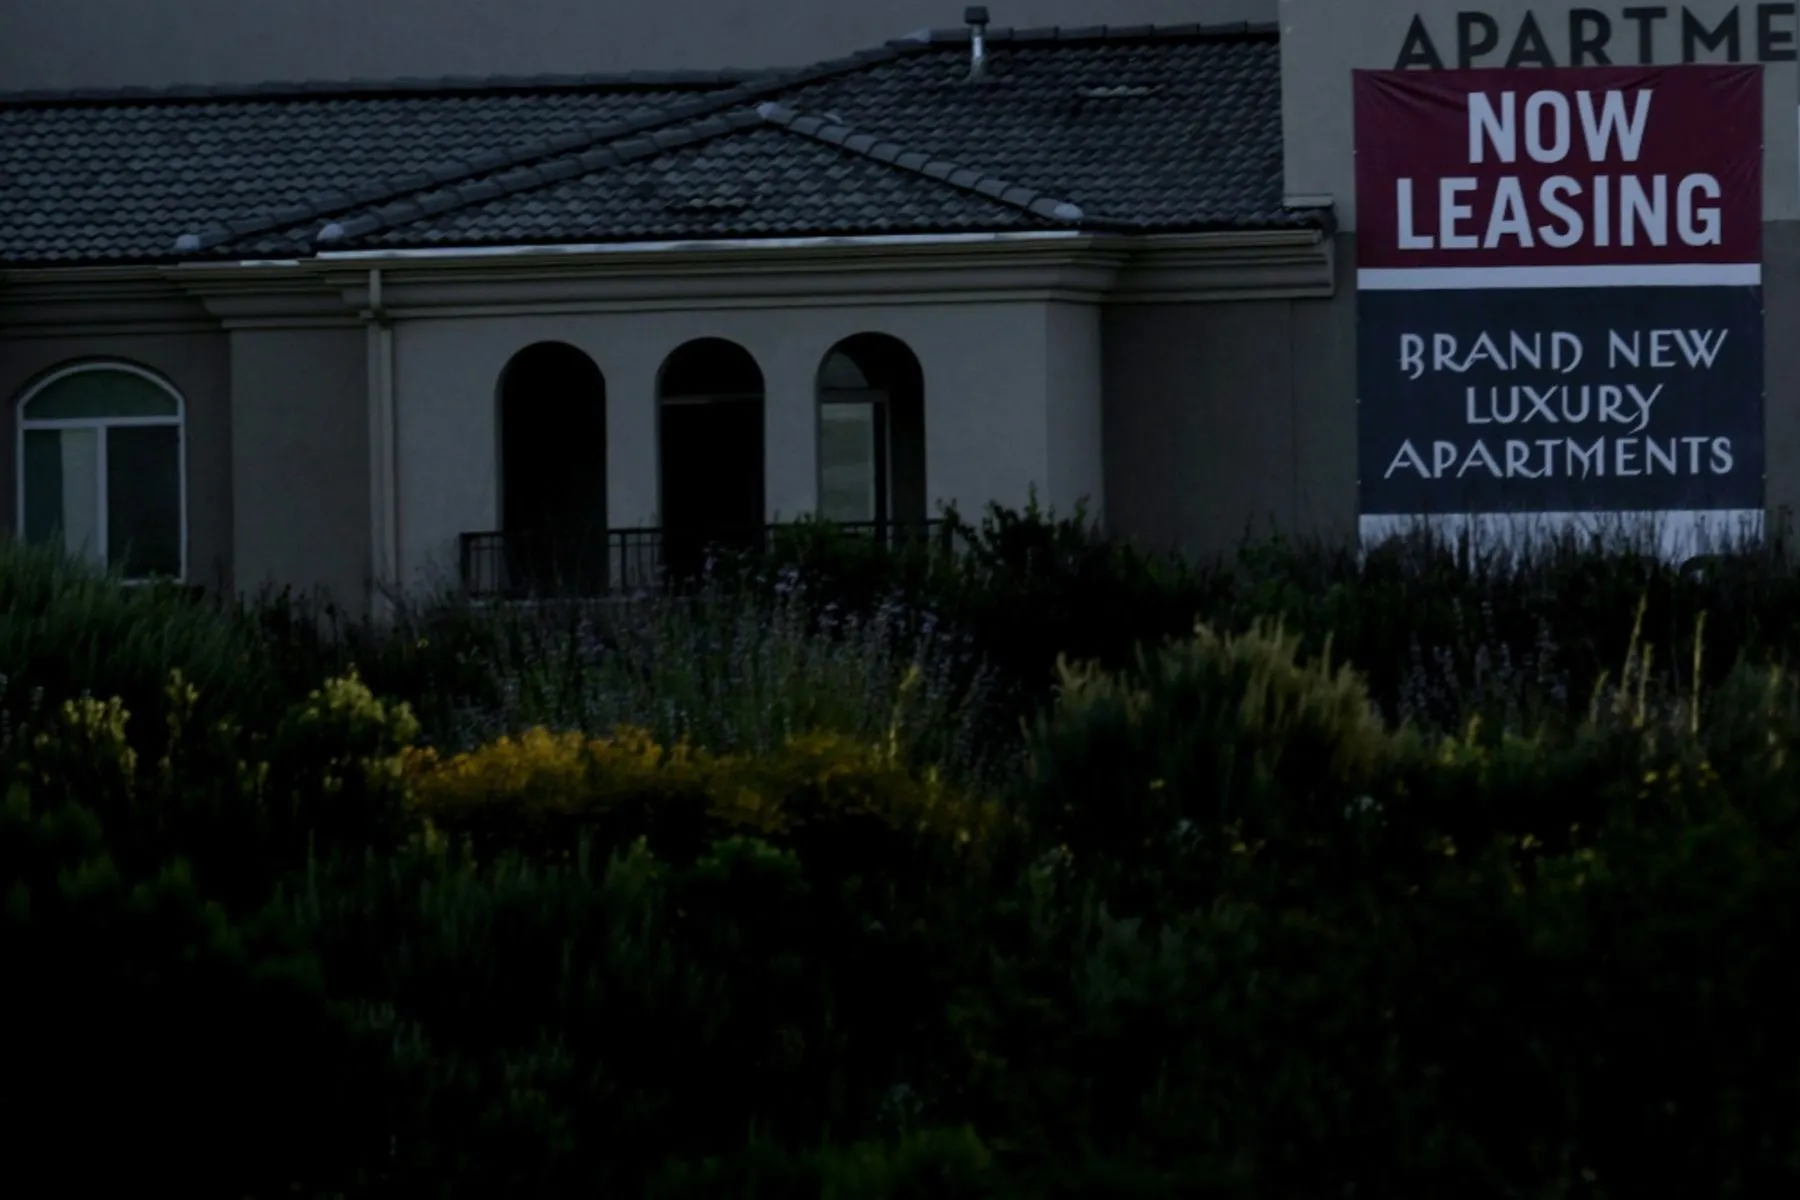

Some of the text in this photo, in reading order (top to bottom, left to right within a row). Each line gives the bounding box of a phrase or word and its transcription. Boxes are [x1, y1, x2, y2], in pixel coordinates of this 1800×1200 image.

[1466, 88, 1654, 164] NOW
[1396, 172, 1723, 250] LEASING
[1398, 328, 1730, 380] BRAND NEW
[1466, 384, 1665, 435] LUXURY
[1383, 435, 1736, 481] APARTMENTS
